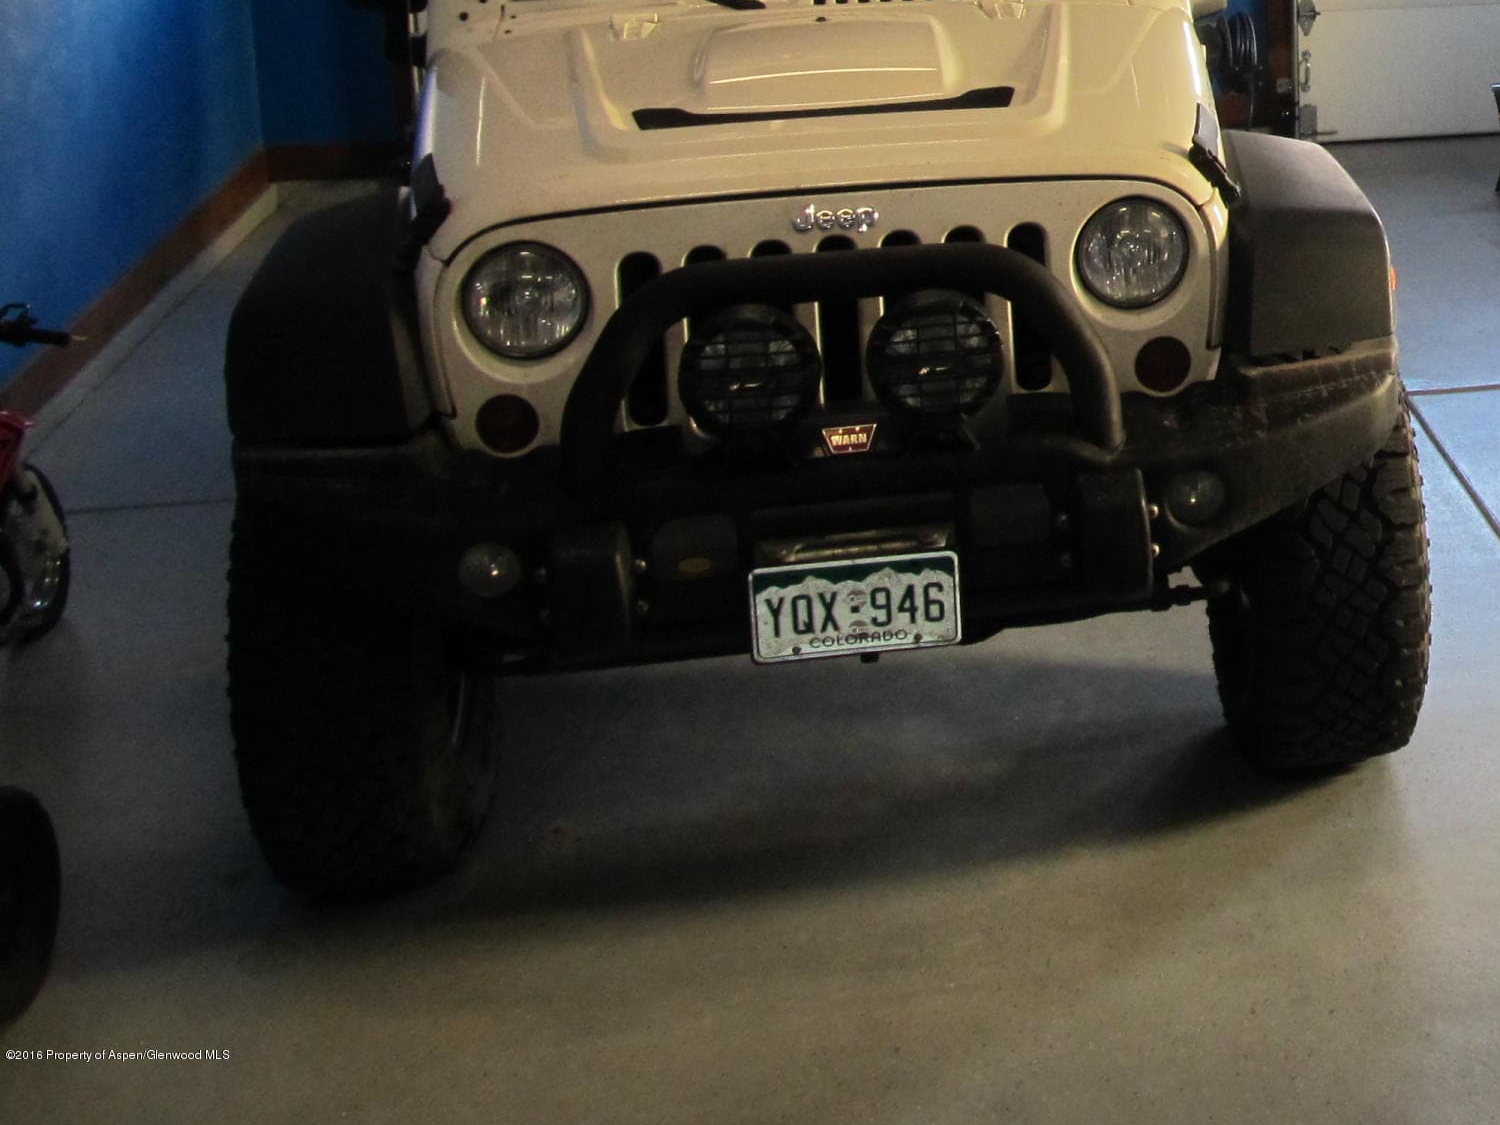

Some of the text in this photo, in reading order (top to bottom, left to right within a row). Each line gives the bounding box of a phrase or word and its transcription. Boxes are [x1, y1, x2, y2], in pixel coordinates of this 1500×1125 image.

[793, 203, 880, 233] Jeep
[830, 433, 868, 447] WARN
[809, 628, 909, 649] COLORADO
